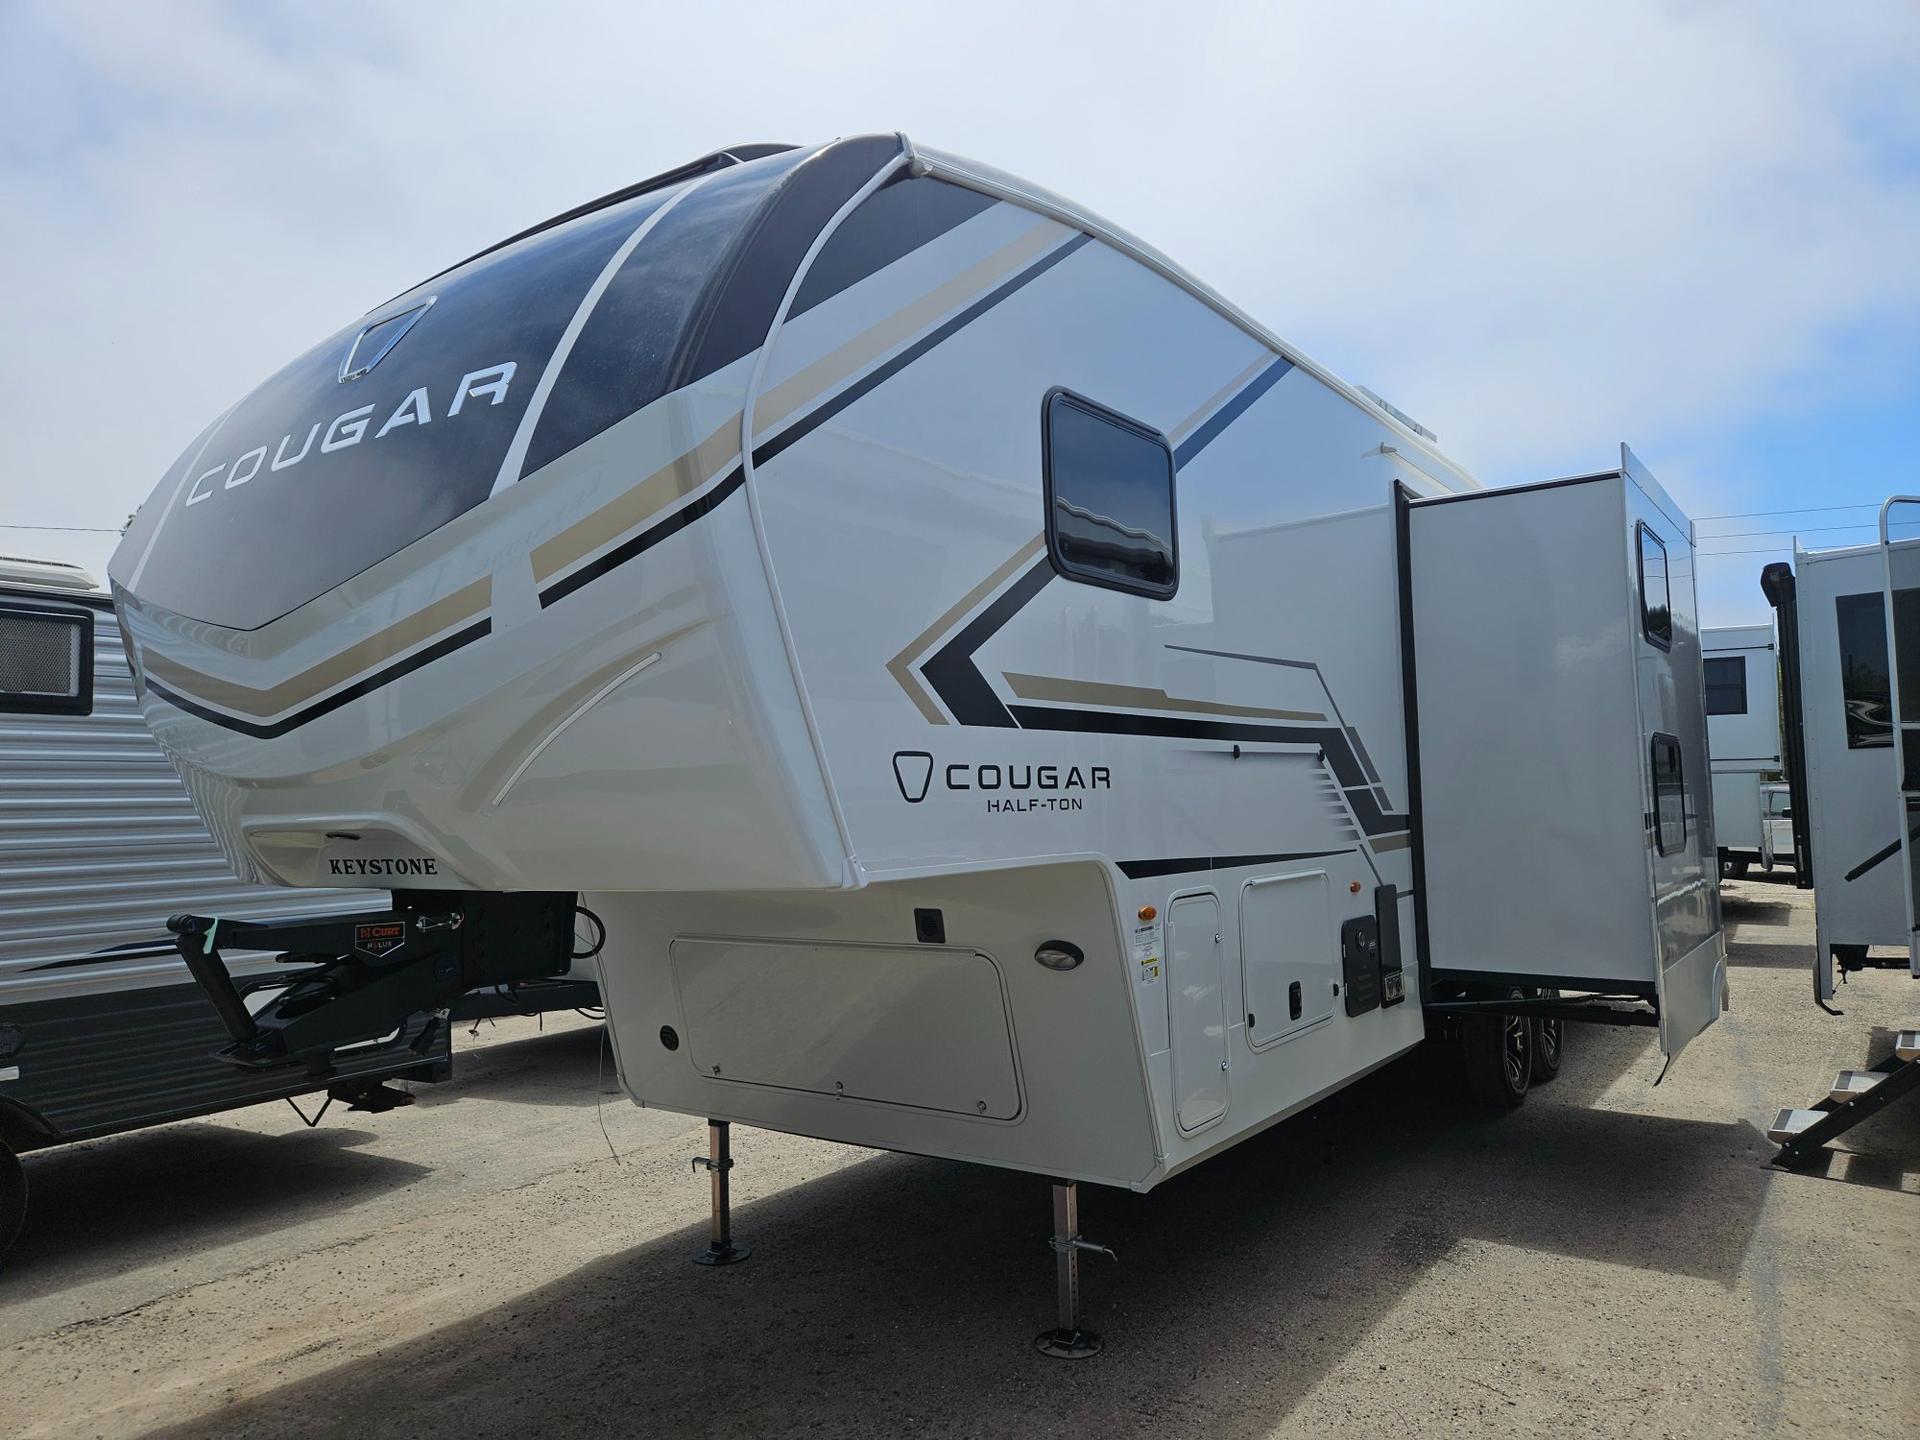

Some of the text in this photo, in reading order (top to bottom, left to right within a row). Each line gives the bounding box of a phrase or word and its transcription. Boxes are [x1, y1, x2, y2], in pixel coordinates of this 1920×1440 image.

[186, 361, 517, 507] COUGAR
[946, 764, 1111, 789] COUGAR
[987, 799, 1082, 812] HALF-TON
[328, 859, 438, 875] KEYSTONE
[372, 927, 401, 937] CURT
